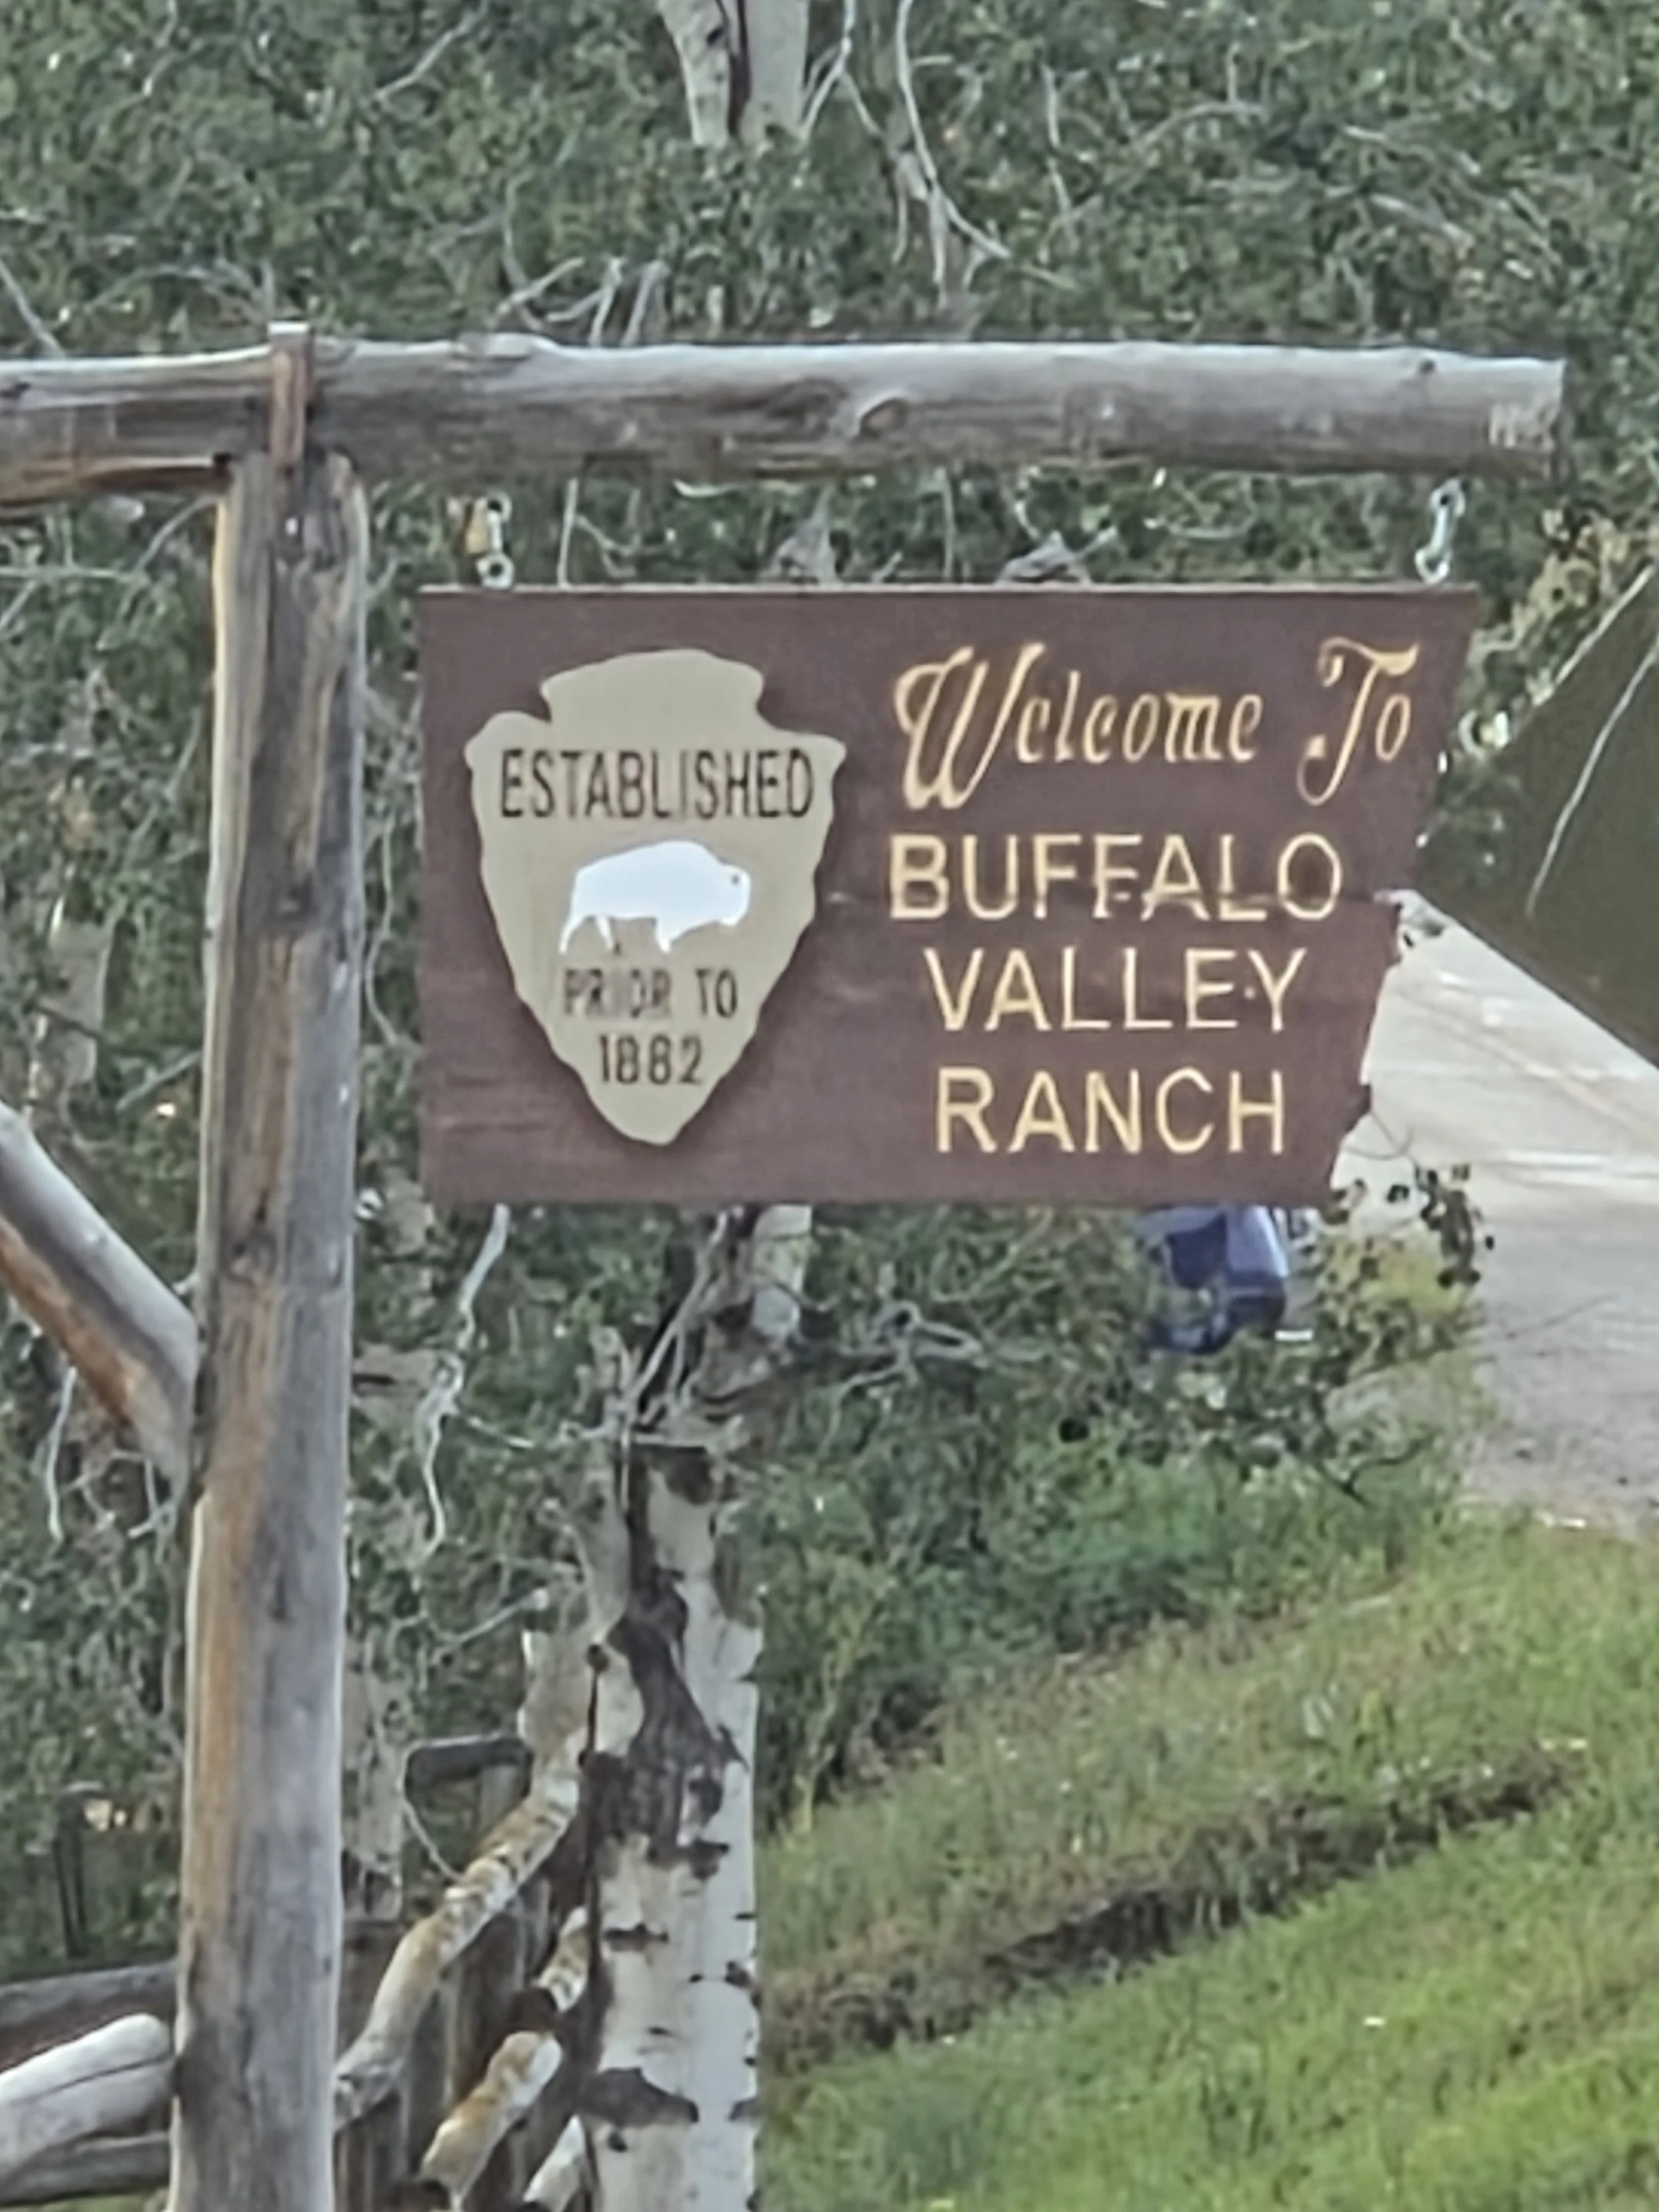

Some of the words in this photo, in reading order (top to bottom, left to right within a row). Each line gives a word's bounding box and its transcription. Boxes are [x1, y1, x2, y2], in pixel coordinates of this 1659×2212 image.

[895, 642, 1263, 810] Welcome
[1296, 637, 1419, 806] To
[500, 749, 814, 819] ESTABLISHED
[889, 833, 1342, 921] BUFFALO
[695, 968, 738, 1017] TO
[923, 946, 1307, 1032] VALLEY
[599, 1035, 703, 1085] 1882
[937, 1068, 1284, 1155] RANCH
